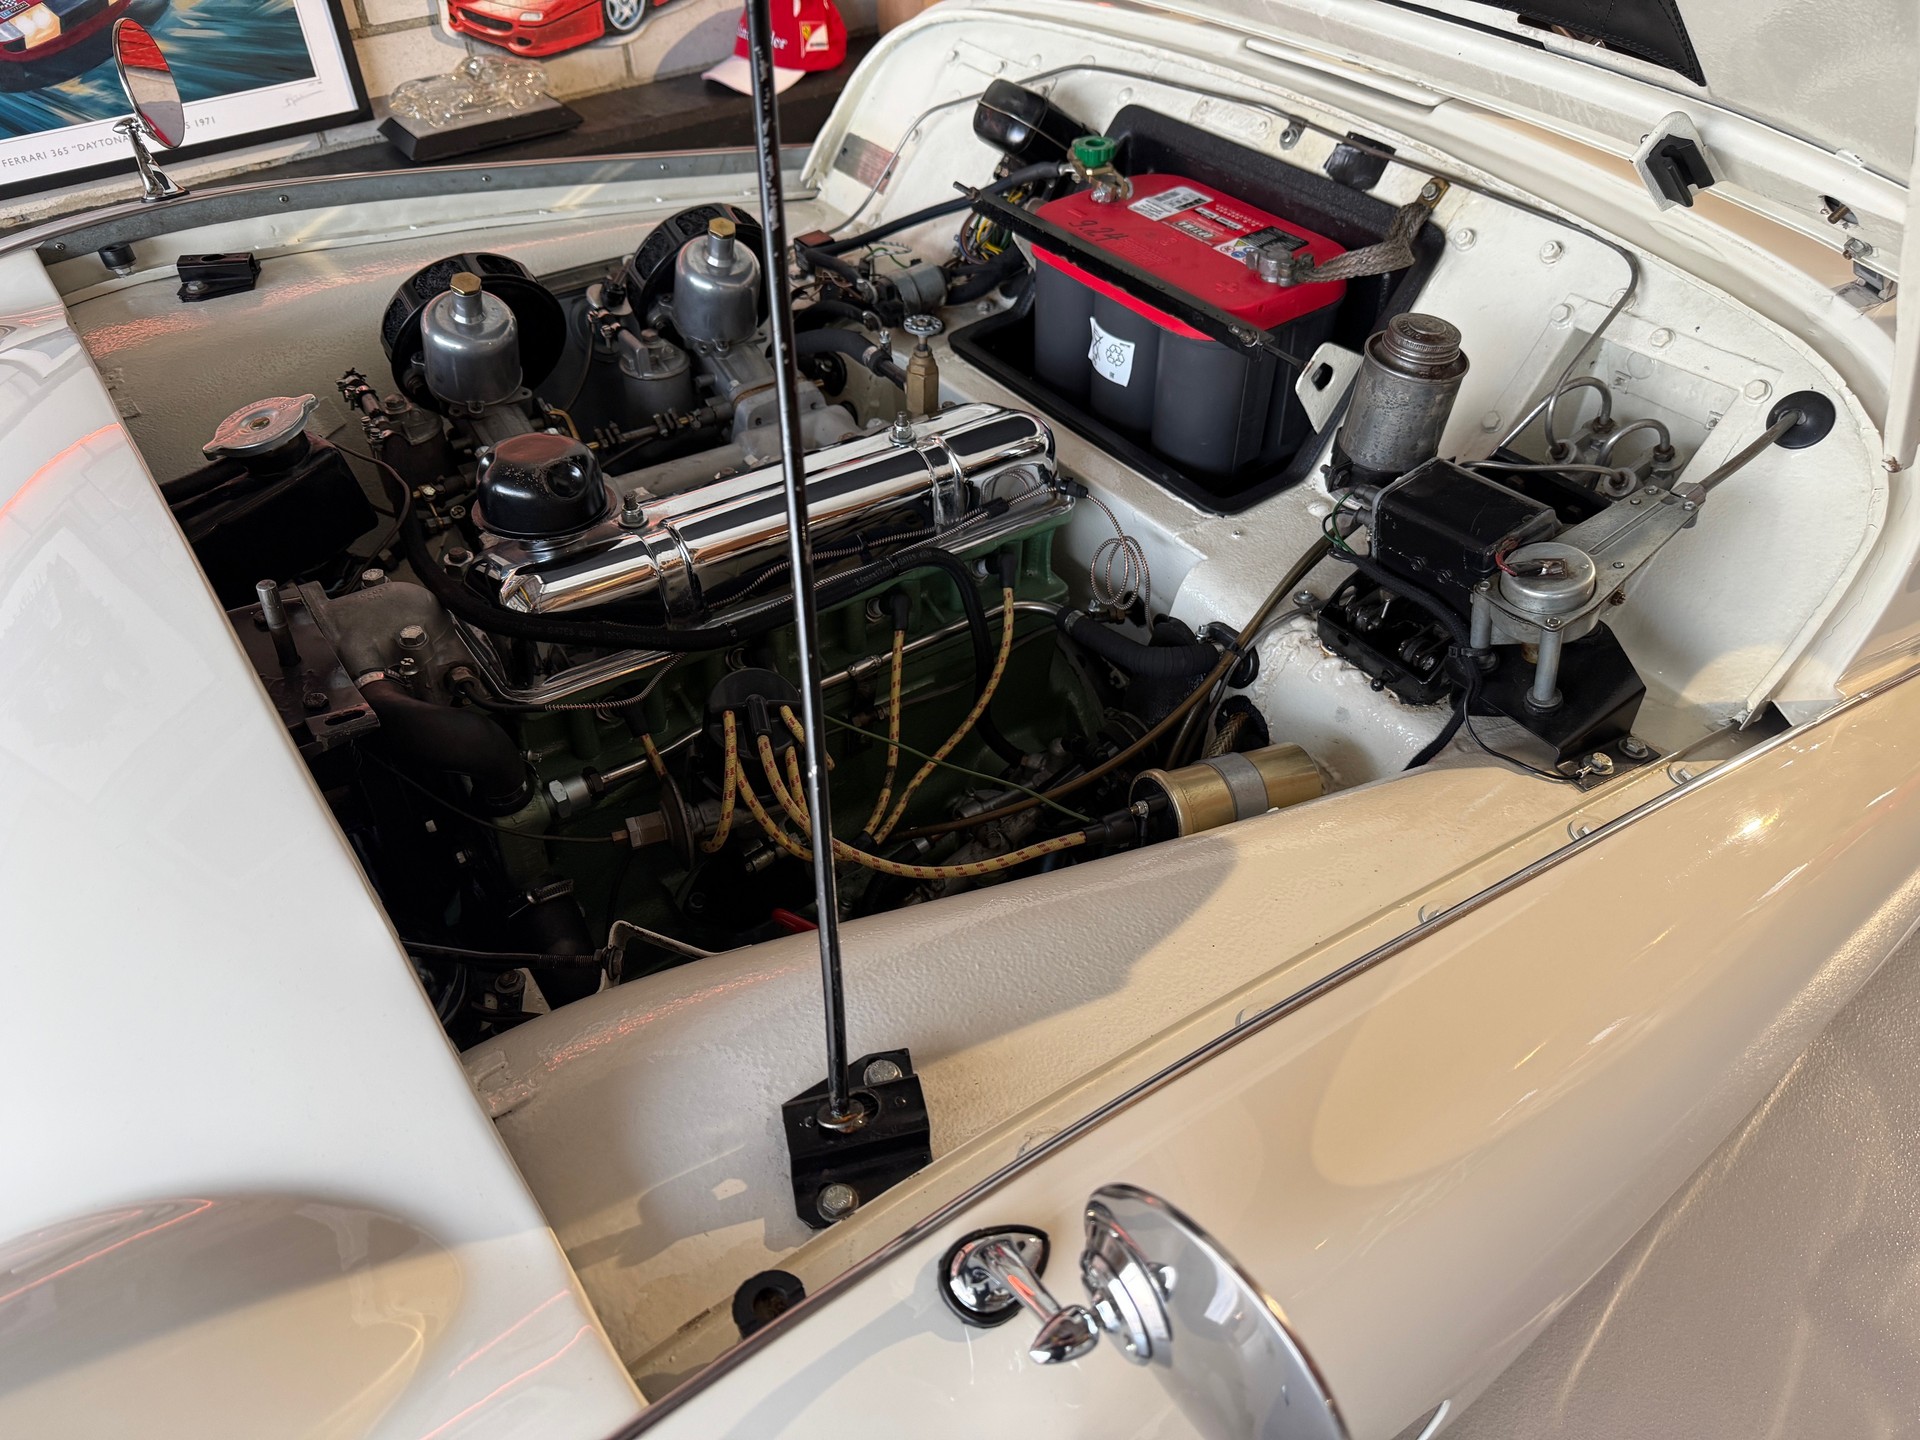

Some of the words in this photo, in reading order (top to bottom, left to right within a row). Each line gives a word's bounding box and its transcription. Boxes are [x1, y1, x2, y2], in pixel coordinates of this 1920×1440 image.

[1, 151, 47, 168] FERRARI
[51, 146, 69, 158] 365
[195, 117, 216, 127] 1971
